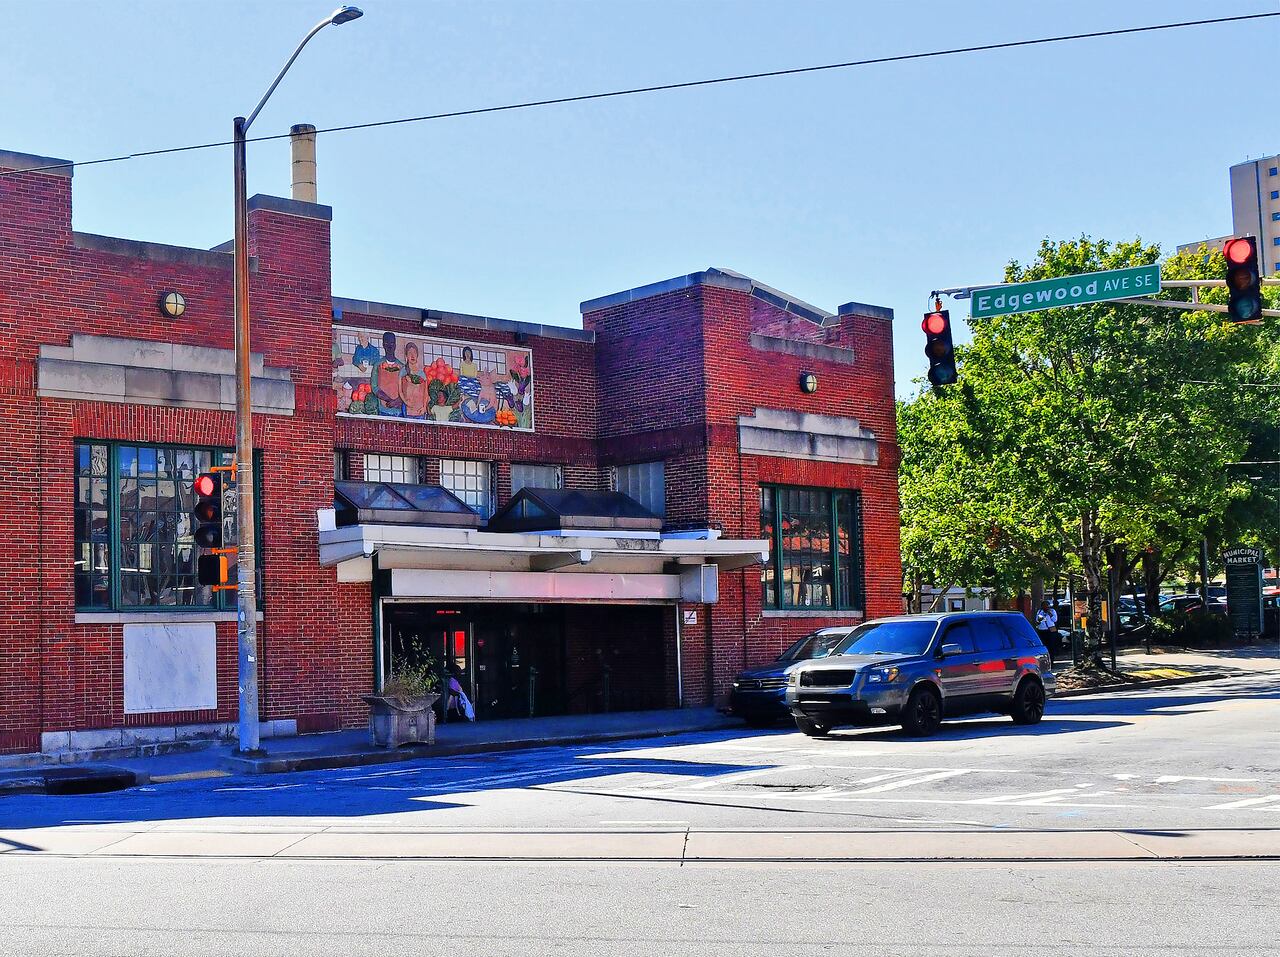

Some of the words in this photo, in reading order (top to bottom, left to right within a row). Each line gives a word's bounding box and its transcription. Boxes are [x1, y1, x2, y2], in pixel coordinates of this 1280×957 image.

[977, 280, 1098, 311] Edgewood
[1103, 277, 1130, 292] AVE
[1134, 274, 1153, 288] SE
[1223, 548, 1259, 559] MUNICIPAL
[1227, 556, 1257, 564] MARKET
